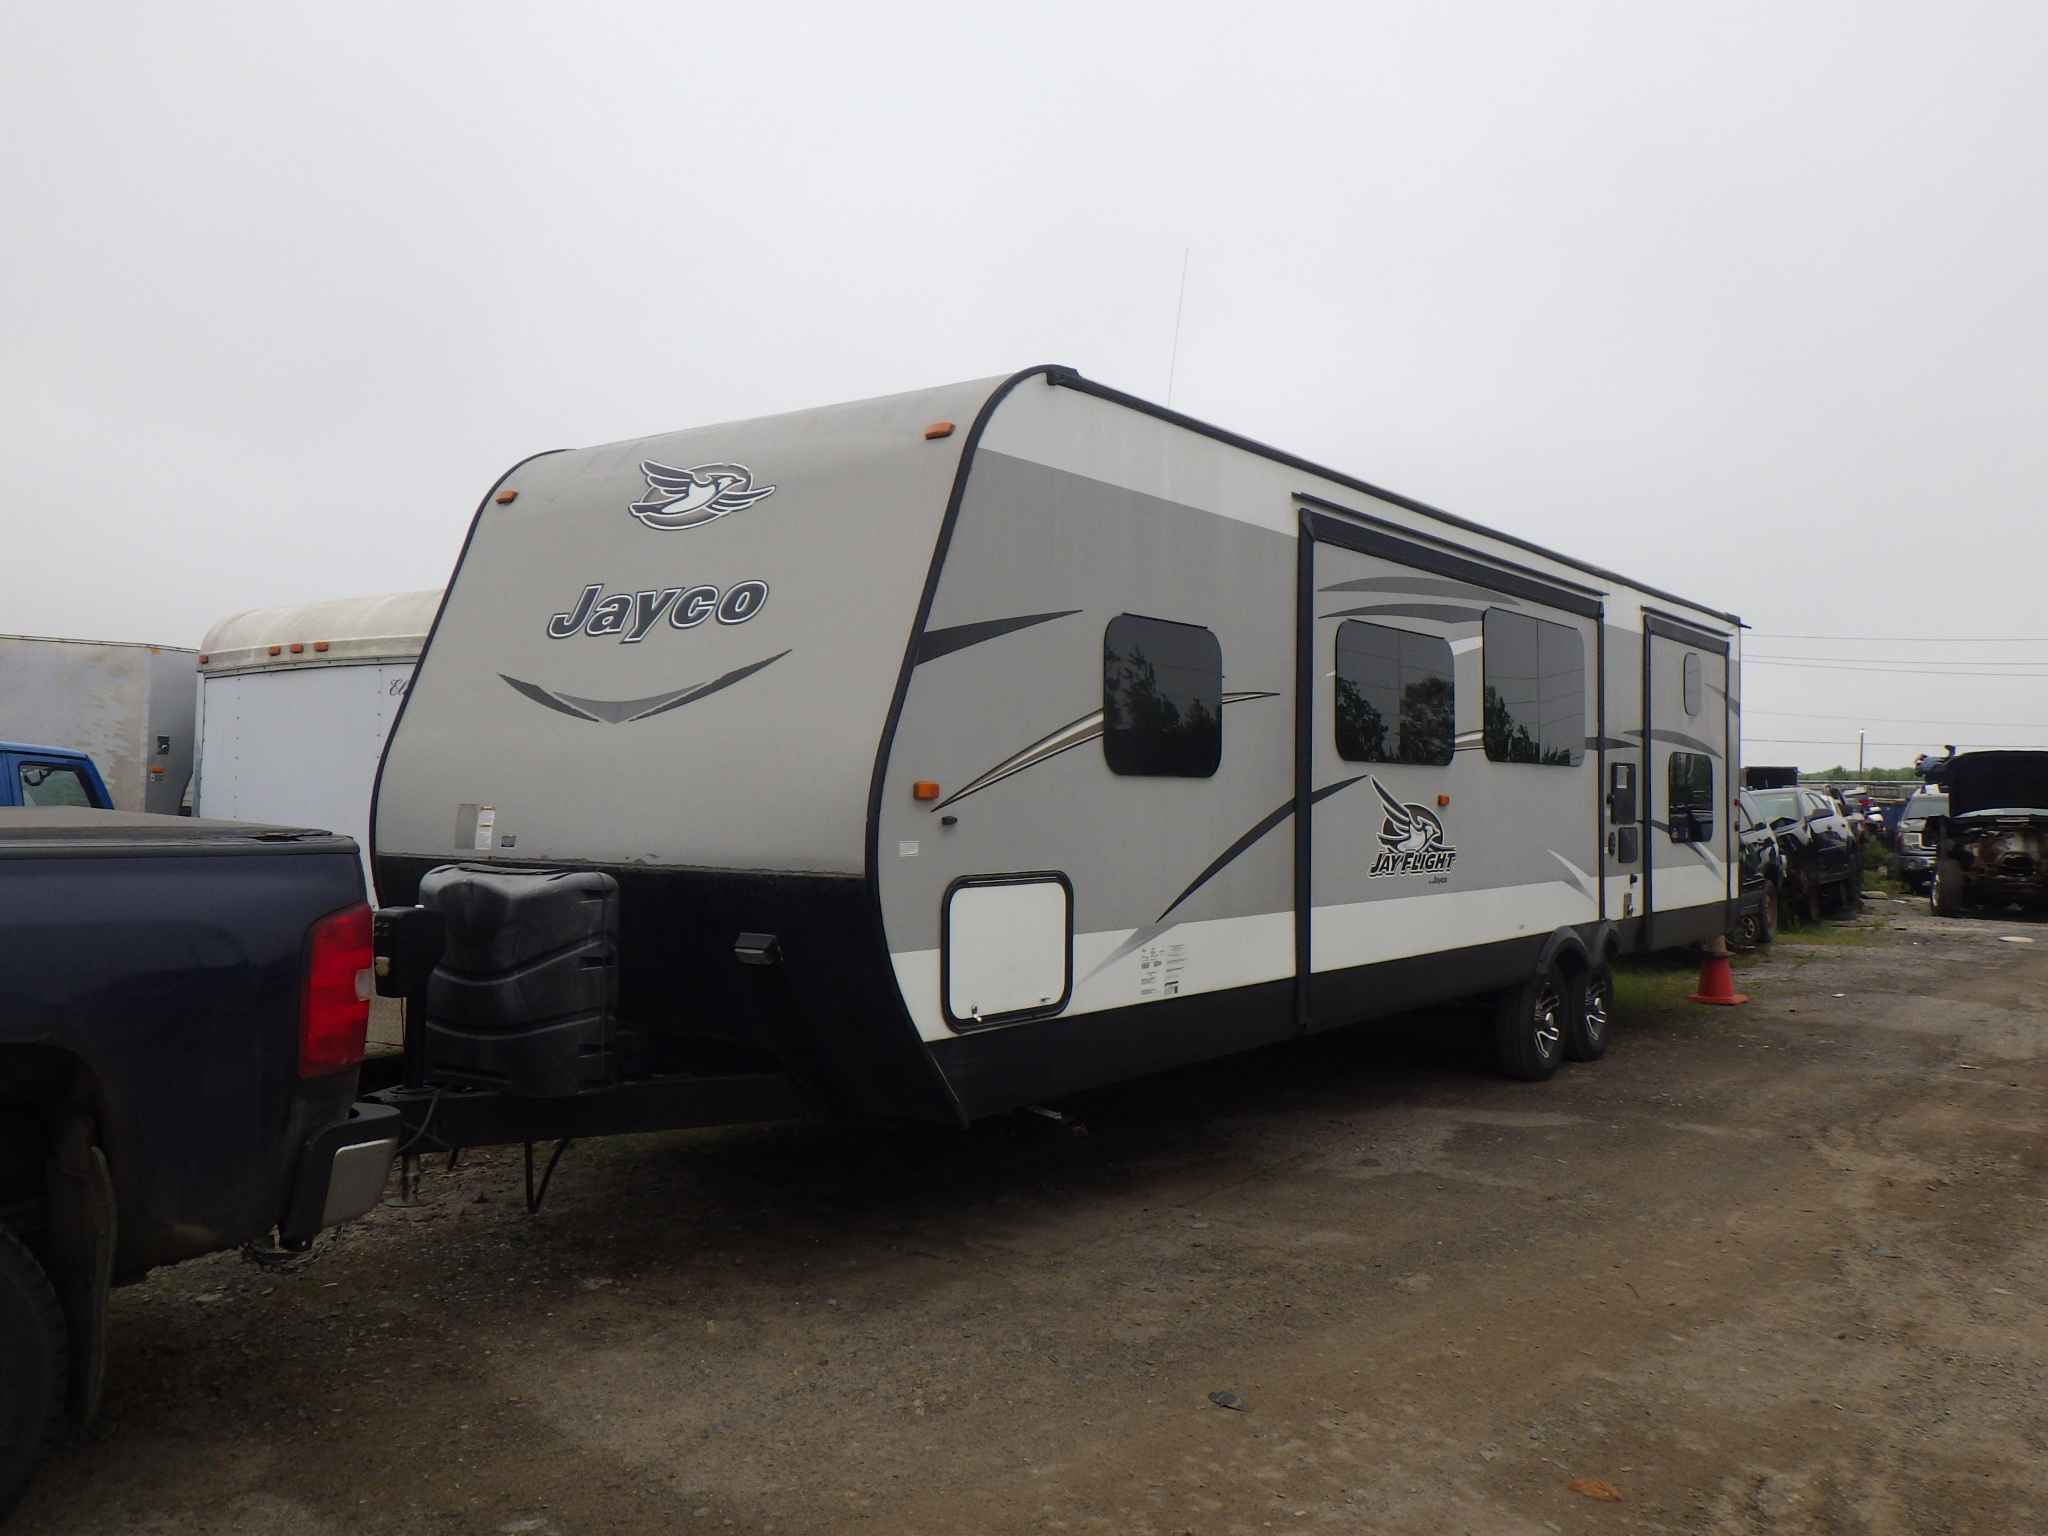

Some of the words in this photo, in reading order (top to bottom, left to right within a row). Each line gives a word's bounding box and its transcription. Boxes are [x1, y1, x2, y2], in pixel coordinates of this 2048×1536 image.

[547, 580, 769, 644] Jayco
[1370, 852, 1403, 877] JAY
[1401, 850, 1456, 875] FLIGHT
